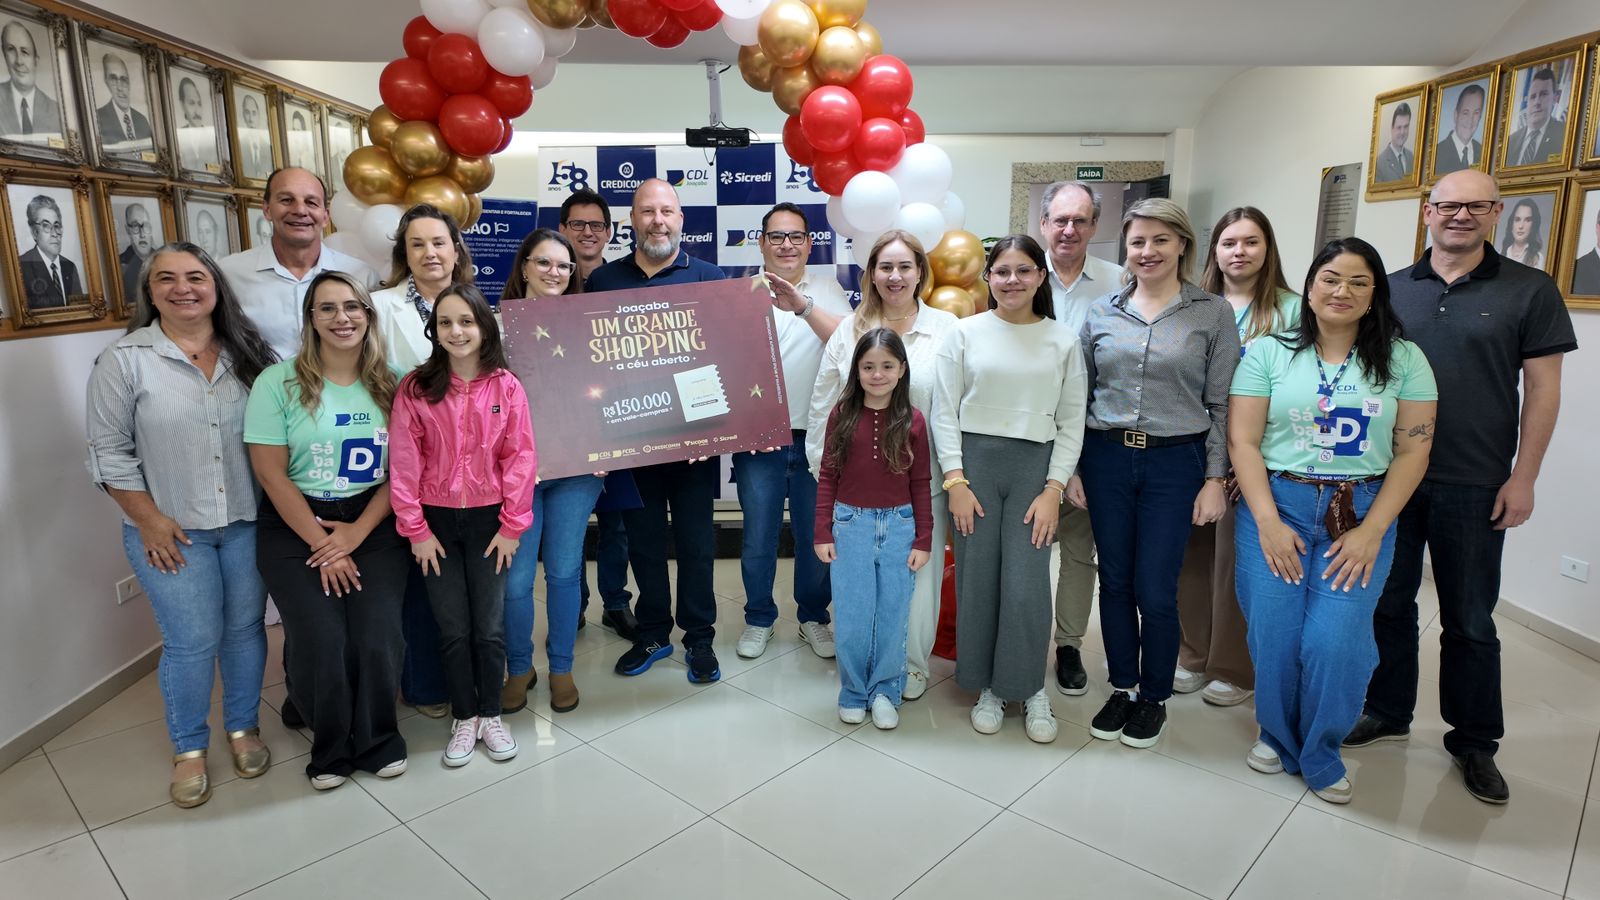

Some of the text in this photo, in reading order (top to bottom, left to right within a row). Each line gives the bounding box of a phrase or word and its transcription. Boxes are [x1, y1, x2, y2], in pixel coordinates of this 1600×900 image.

[686, 169, 709, 180] CDL
[734, 172, 772, 183] Sicredi
[1079, 169, 1101, 178] SAÍDA
[600, 180, 645, 189] CREDICOM
[747, 230, 763, 240] CD
[809, 231, 832, 241] OOB
[615, 301, 670, 314] Joaçaba
[591, 309, 698, 338] UM GRANDE
[589, 327, 707, 363] SHOPPING
[616, 355, 690, 371] a céu aberto
[352, 412, 371, 421] CDL
[622, 407, 669, 422] vale-compras
[1288, 406, 1314, 421] Sá
[1291, 422, 1314, 437] ba
[1335, 417, 1361, 444] D
[309, 441, 334, 455] Sá
[313, 456, 334, 468] ba
[347, 447, 375, 472] D
[308, 469, 334, 481] do
